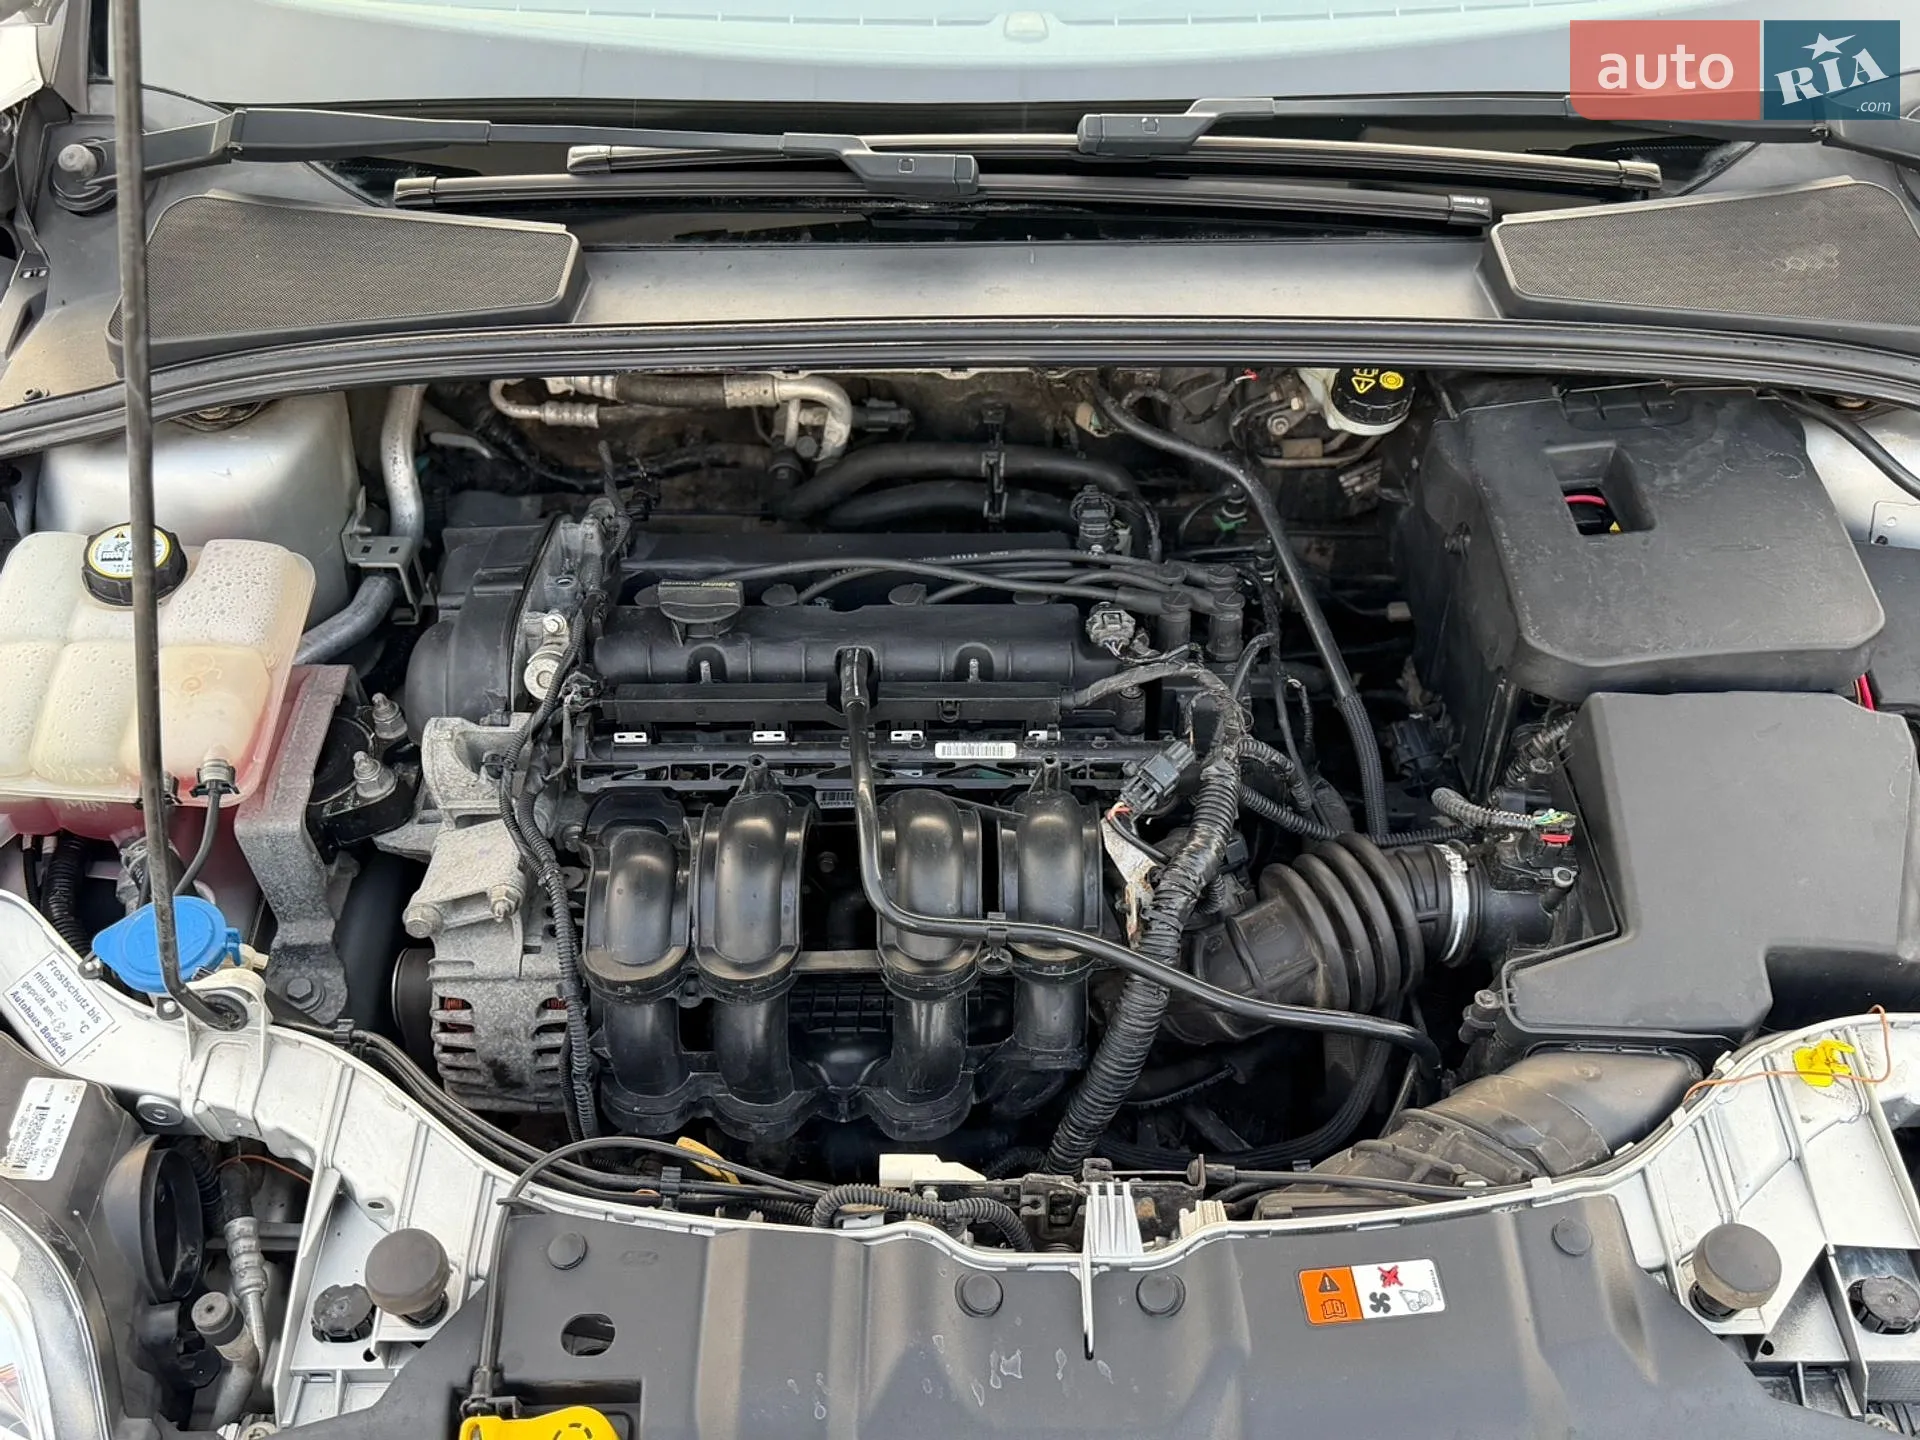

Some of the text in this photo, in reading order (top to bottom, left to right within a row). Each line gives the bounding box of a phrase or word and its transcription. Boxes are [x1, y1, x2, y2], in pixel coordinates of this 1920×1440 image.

[33, 971, 58, 998] minus
[46, 959, 102, 1024] Frostschutz bis
[10, 990, 67, 1057] Autohaus Bodach
